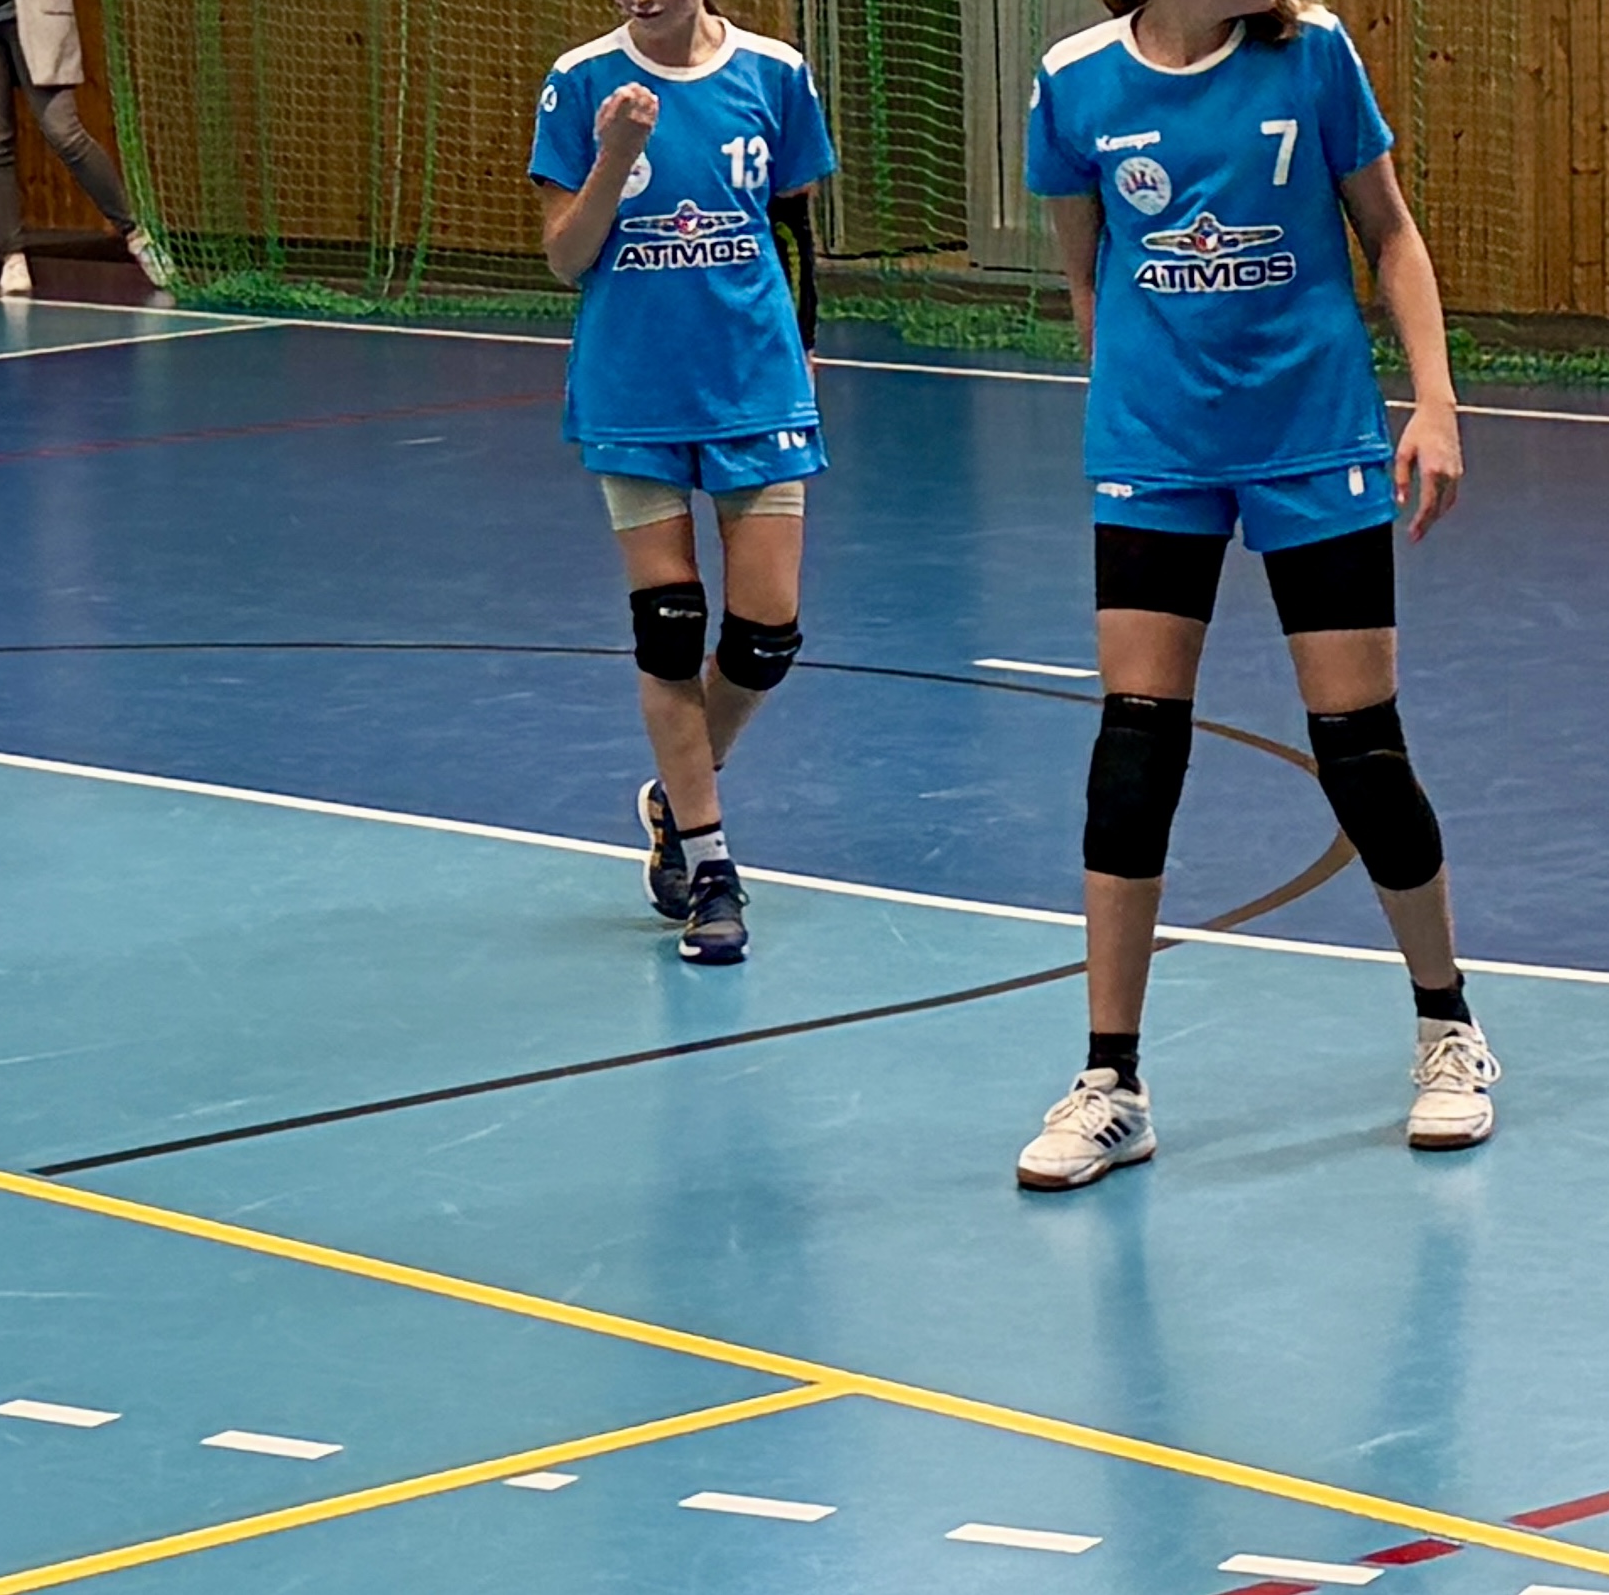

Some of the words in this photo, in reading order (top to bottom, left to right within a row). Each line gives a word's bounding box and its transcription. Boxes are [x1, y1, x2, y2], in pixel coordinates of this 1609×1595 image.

[720, 135, 772, 190] 13
[1260, 118, 1299, 187] 7
[612, 234, 761, 272] ATMOS
[1134, 251, 1297, 294] ATMOS
